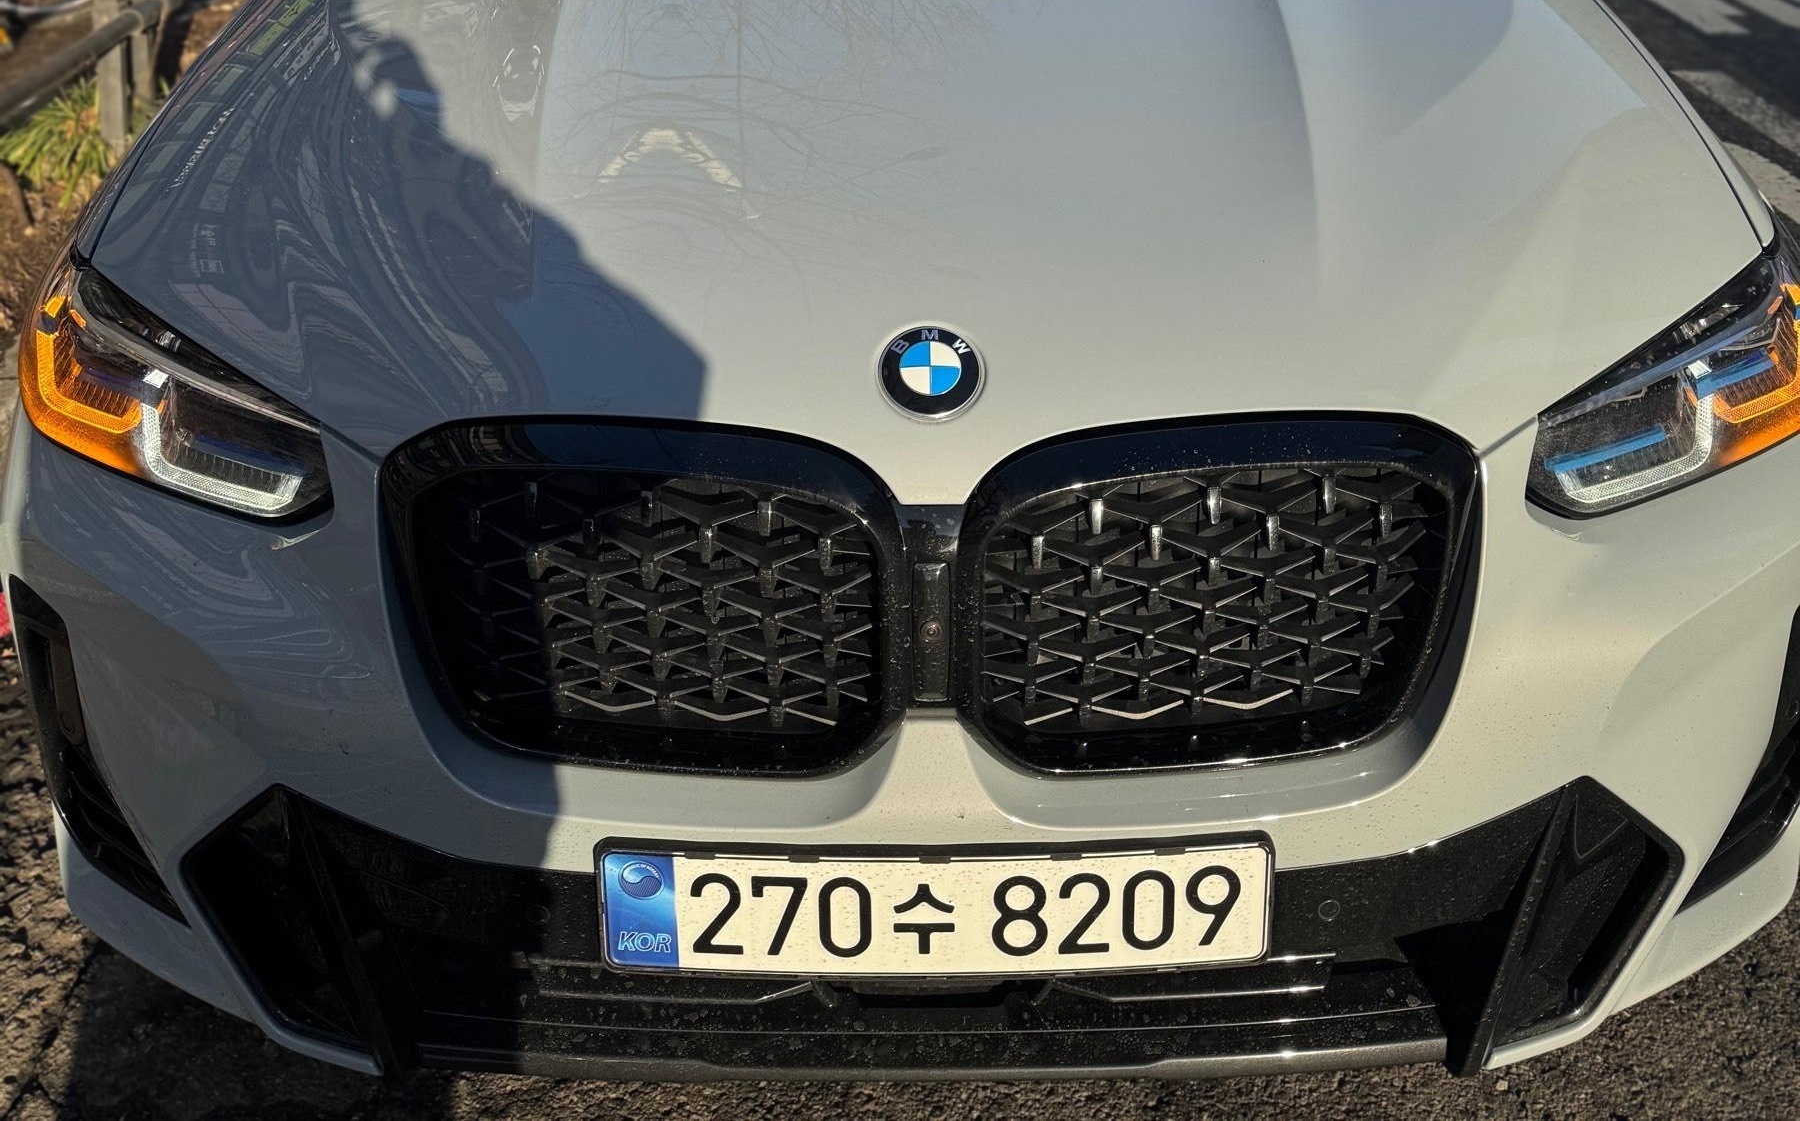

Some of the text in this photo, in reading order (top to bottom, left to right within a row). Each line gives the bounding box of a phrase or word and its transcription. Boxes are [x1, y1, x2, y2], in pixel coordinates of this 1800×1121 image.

[890, 329, 971, 355] BMW
[690, 865, 1241, 958] 270수 8209
[618, 931, 671, 953] KOR
